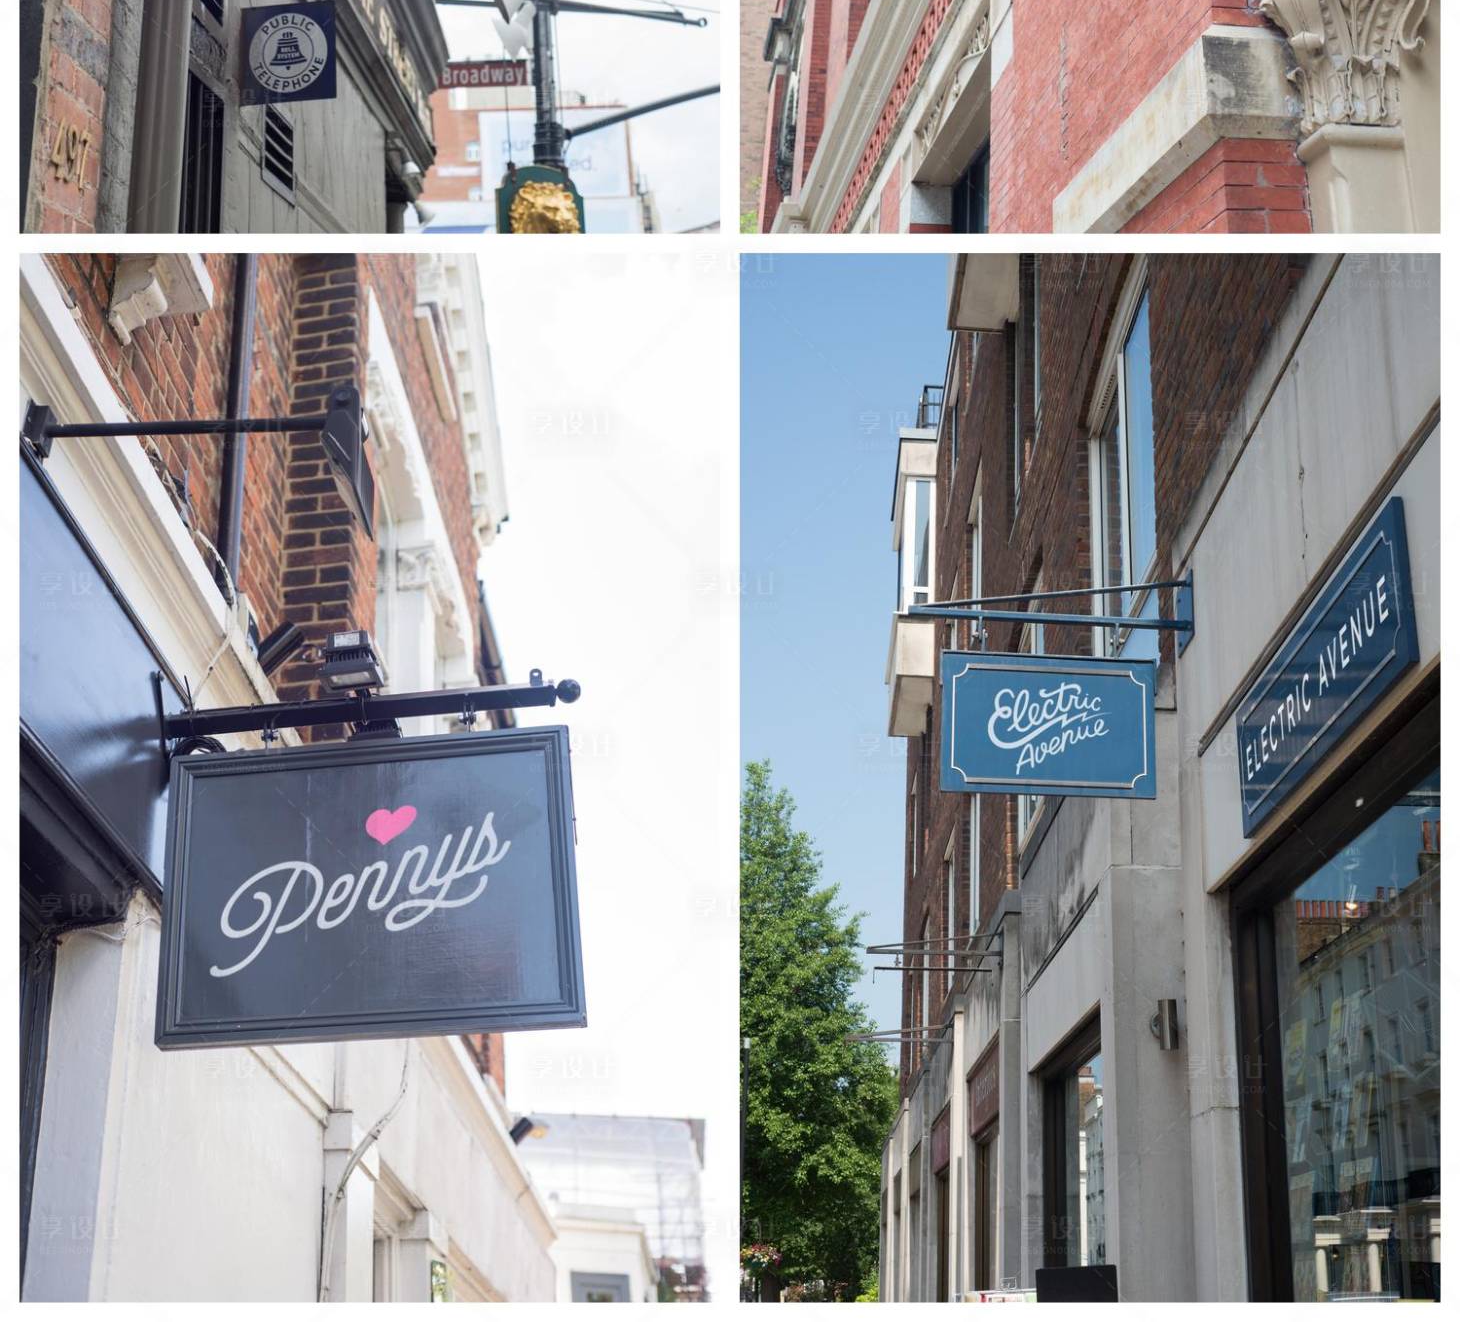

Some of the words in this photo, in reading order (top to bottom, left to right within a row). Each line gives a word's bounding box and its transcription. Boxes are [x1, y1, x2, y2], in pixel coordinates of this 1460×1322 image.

[261, 14, 314, 36] PUBLIC
[254, 56, 324, 91] TELEPHONE
[442, 63, 525, 86] Broadway
[51, 118, 92, 189] 497
[1245, 673, 1312, 781] ELECTRIC
[1318, 574, 1390, 697] AVENUE
[987, 682, 1104, 750] Electric
[1015, 718, 1110, 776] Avenue
[209, 811, 512, 978] Pennys
